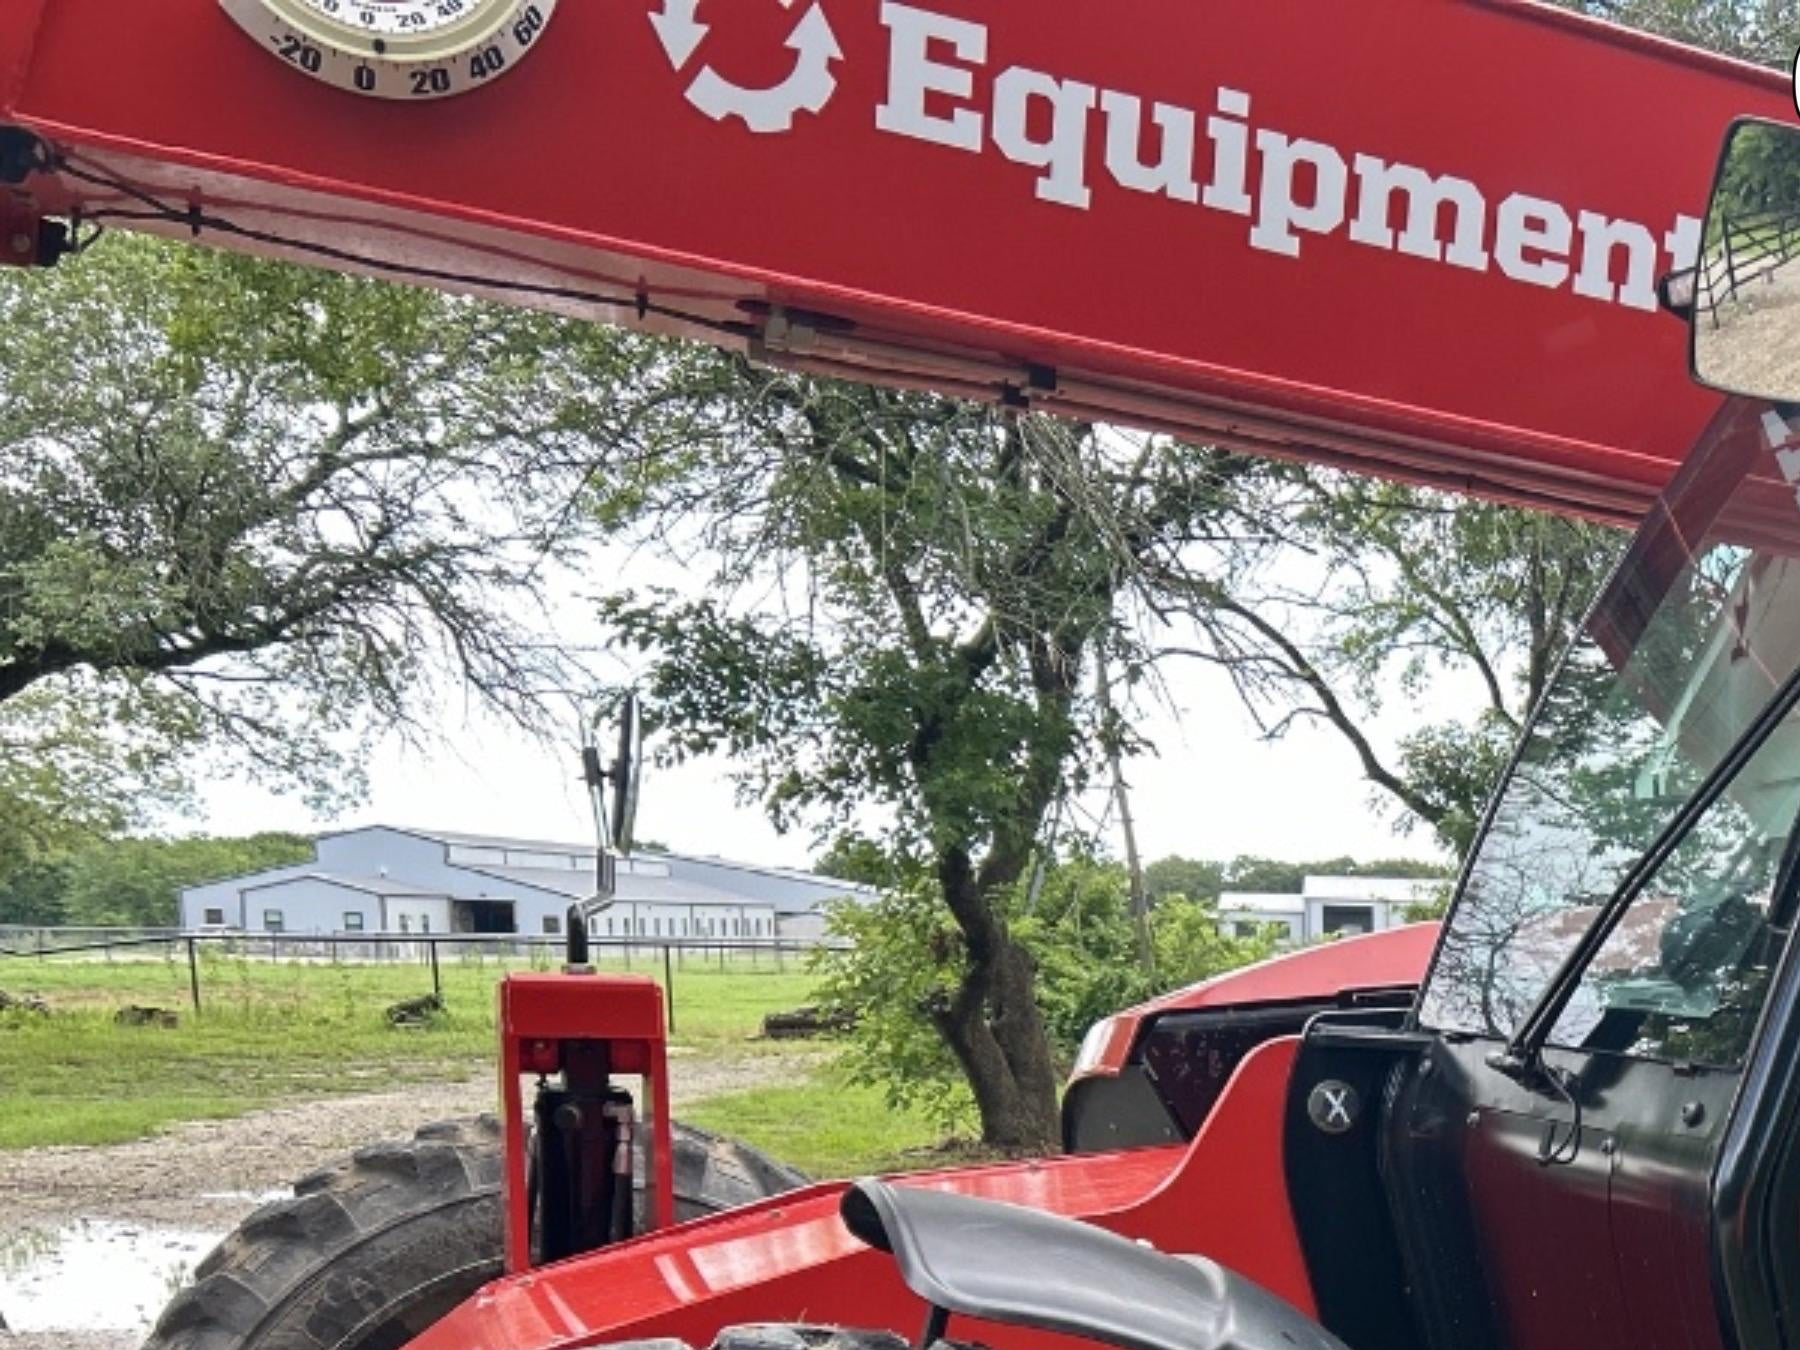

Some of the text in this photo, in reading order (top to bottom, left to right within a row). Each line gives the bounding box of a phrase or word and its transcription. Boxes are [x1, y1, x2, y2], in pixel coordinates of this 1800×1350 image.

[396, 12, 426, 27] 20
[513, 5, 544, 46] 60
[270, 34, 321, 73] -20
[470, 45, 505, 79] 40
[354, 64, 376, 91] 0
[410, 68, 451, 94] 20
